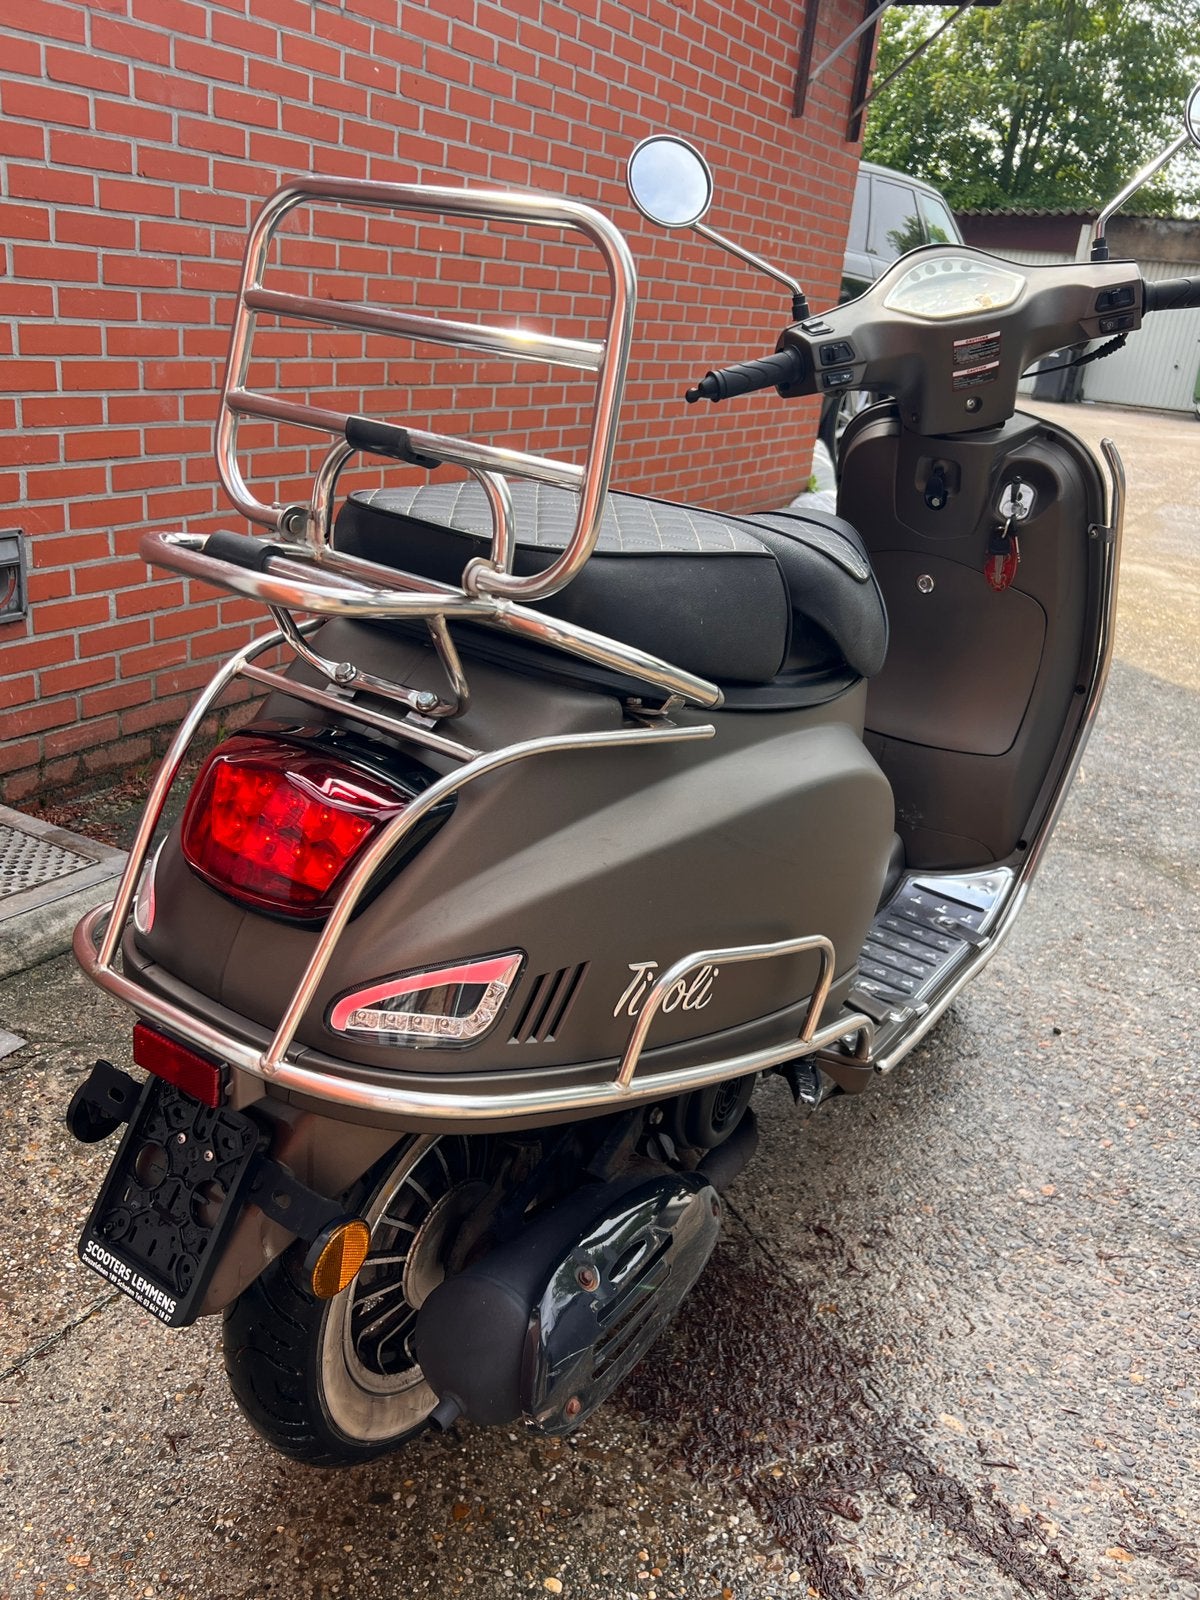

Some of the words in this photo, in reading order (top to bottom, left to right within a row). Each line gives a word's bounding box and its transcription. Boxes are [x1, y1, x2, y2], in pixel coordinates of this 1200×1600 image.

[613, 961, 719, 1018] Tioli
[85, 1240, 132, 1281] SCOOTERS
[131, 1273, 177, 1314] LEMMENS
